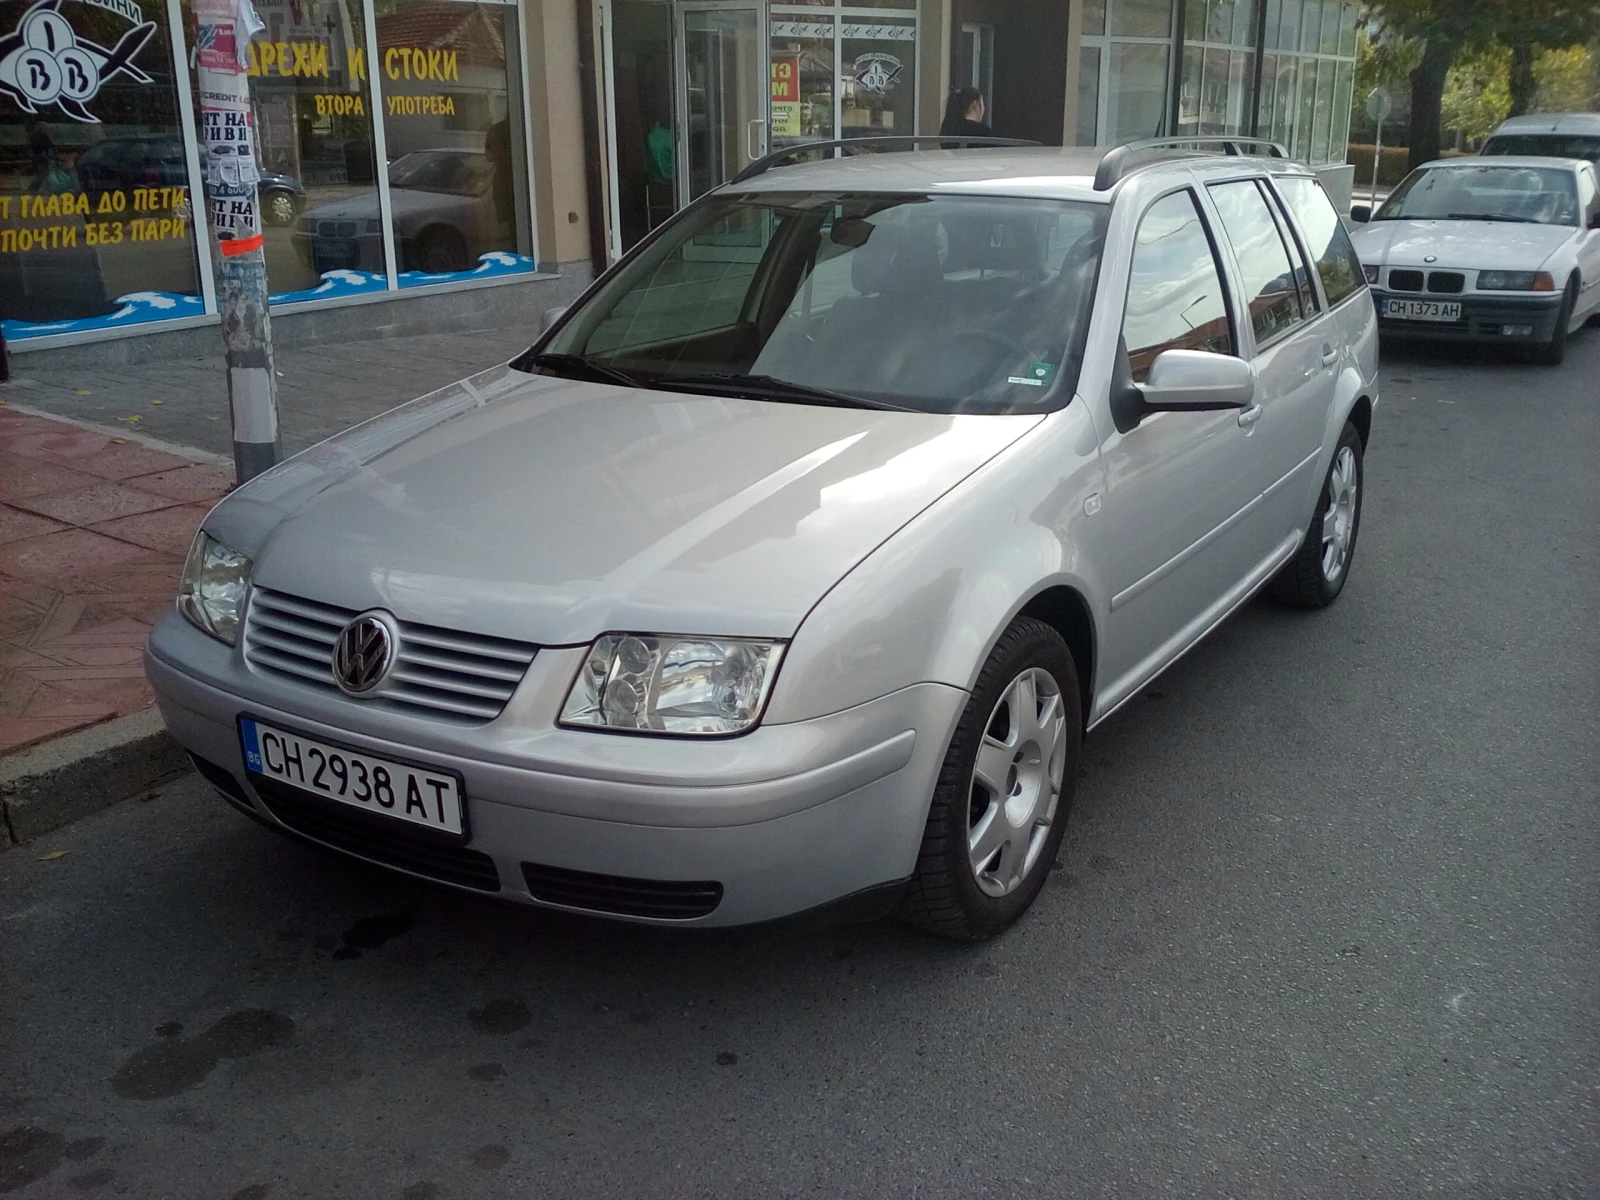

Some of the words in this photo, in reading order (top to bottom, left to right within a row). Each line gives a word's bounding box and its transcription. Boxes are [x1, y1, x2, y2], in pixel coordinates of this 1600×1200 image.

[348, 48, 366, 81] И
[385, 47, 459, 82] СТОКИ
[314, 94, 364, 116] ВТОРА
[387, 95, 455, 116] УПОТРЕБА
[224, 112, 246, 127] НА
[20, 192, 90, 219] ГЛАВА
[97, 190, 126, 214] ДО
[133, 187, 185, 212] ПЕТИ
[230, 200, 253, 216] НА
[2, 225, 77, 253] ПОЧТИ
[85, 222, 124, 246] БЕЗ
[130, 219, 185, 242] ПАРИ
[1389, 301, 1406, 314] CH
[1409, 302, 1439, 316] 1373
[1441, 304, 1459, 317] AH
[247, 750, 261, 766] BG
[262, 732, 305, 783] CH
[308, 747, 395, 809] 2938
[405, 773, 450, 823] AT
